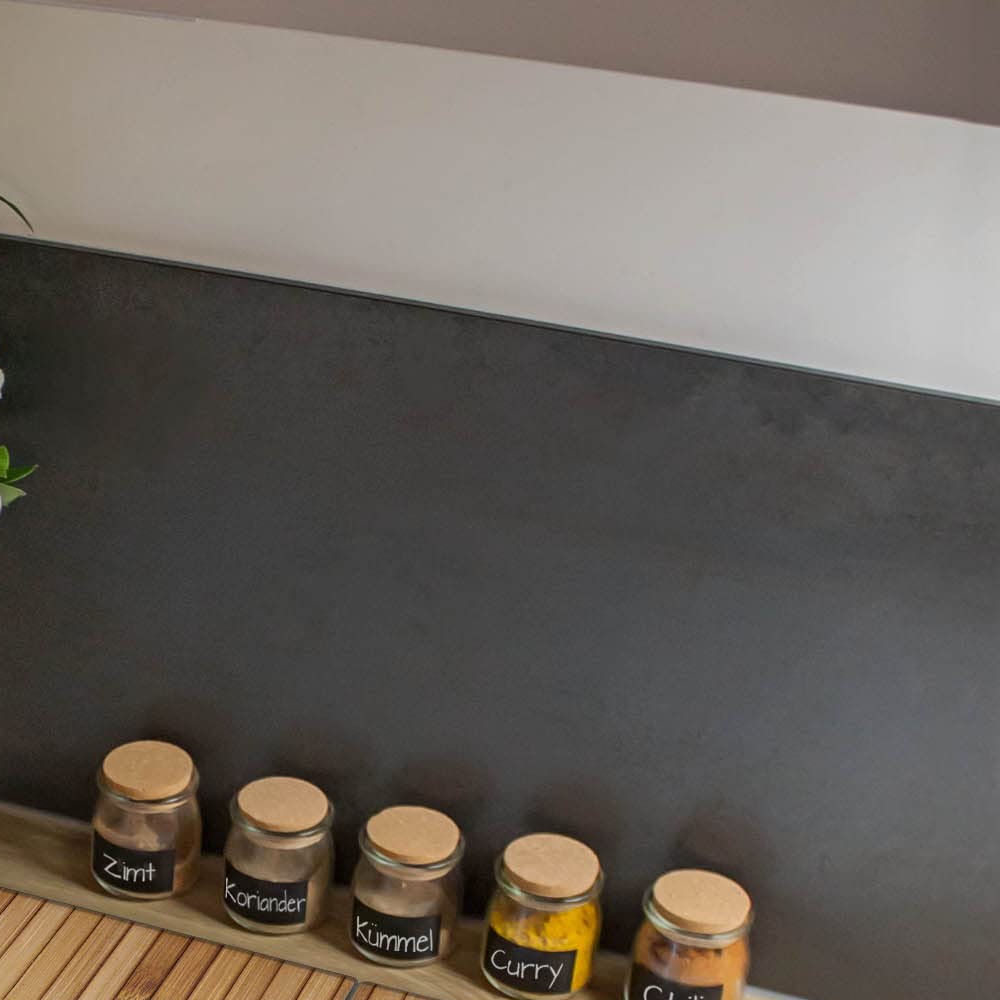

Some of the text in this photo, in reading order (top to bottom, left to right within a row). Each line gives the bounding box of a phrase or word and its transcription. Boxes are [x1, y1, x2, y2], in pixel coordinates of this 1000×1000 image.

[103, 853, 156, 882] Zimt
[224, 877, 306, 913] Koriander
[356, 915, 433, 953] Kümmel
[490, 950, 564, 990] Curry
